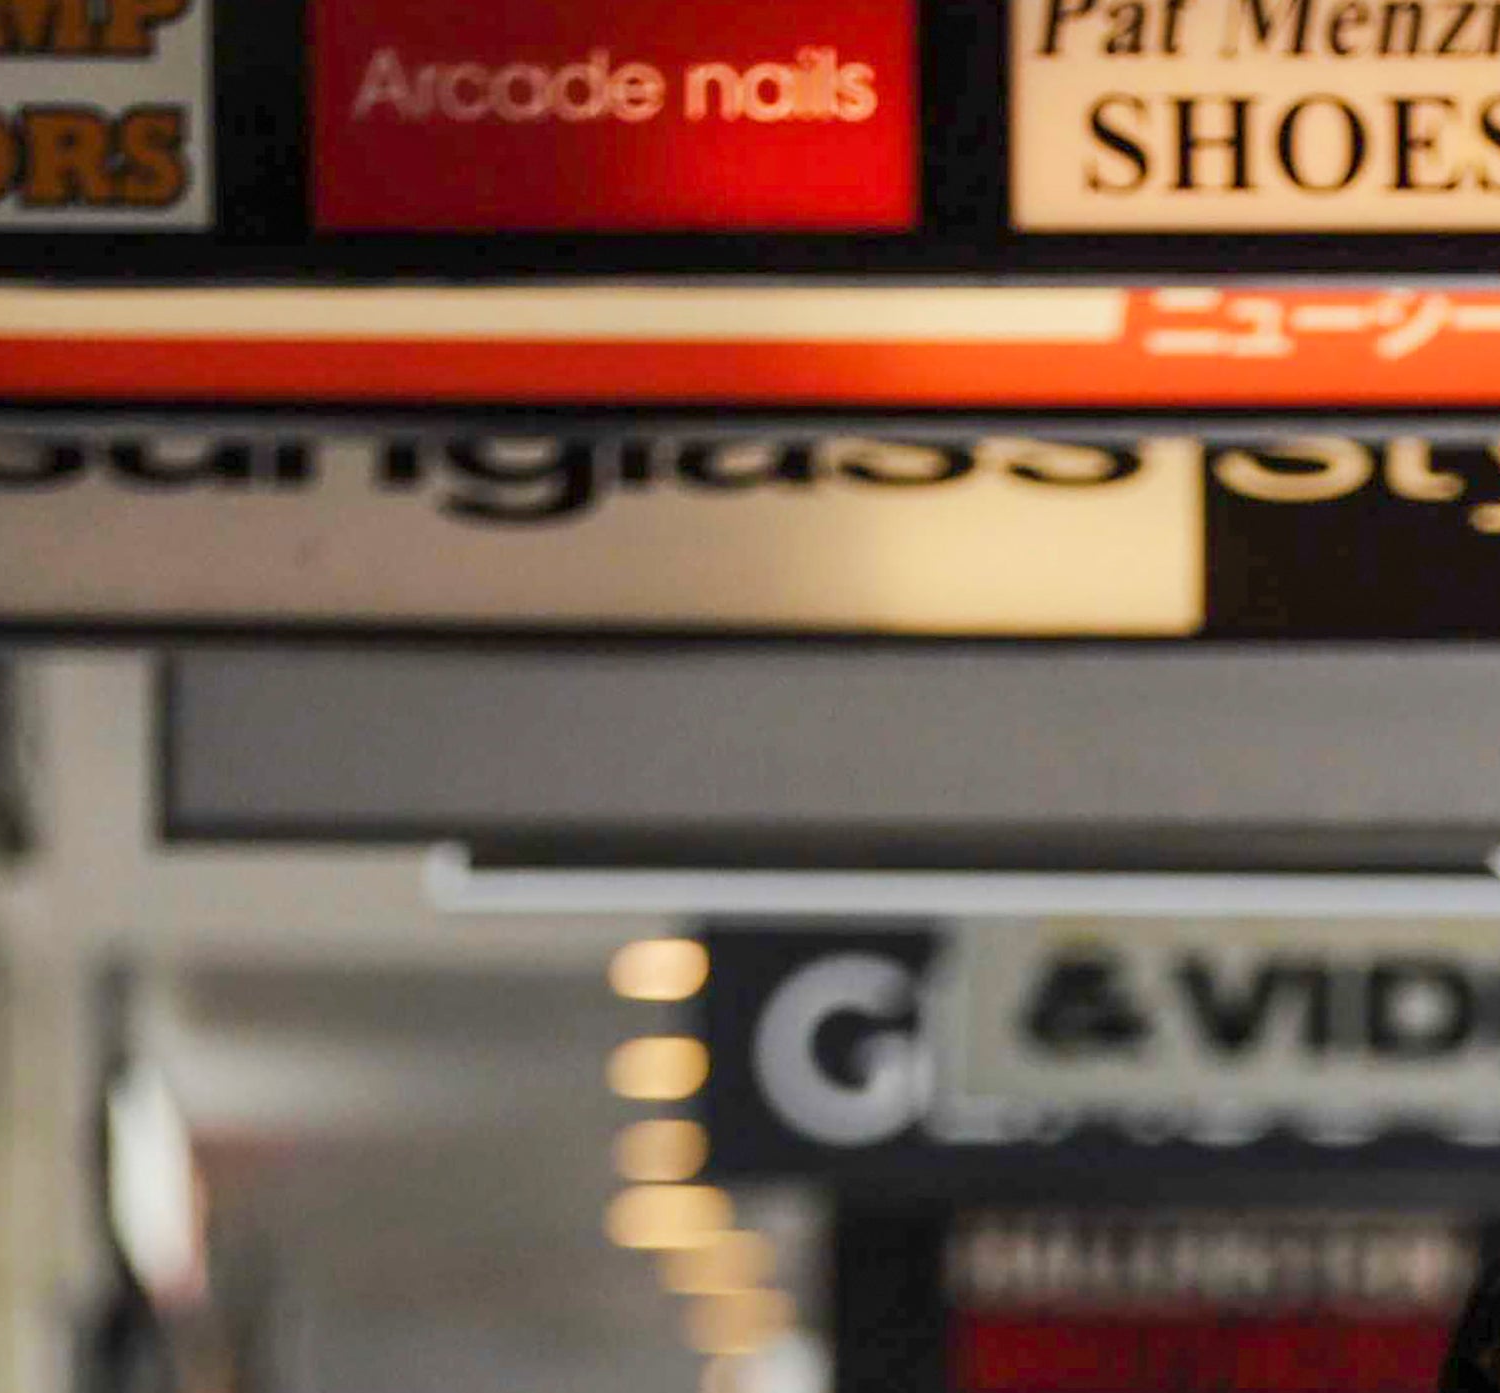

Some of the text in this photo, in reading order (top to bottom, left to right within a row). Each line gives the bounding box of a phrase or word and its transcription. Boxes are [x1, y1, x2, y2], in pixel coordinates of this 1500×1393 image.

[1036, 0, 1186, 56] Pat
[352, 44, 879, 123] Arcade nails
